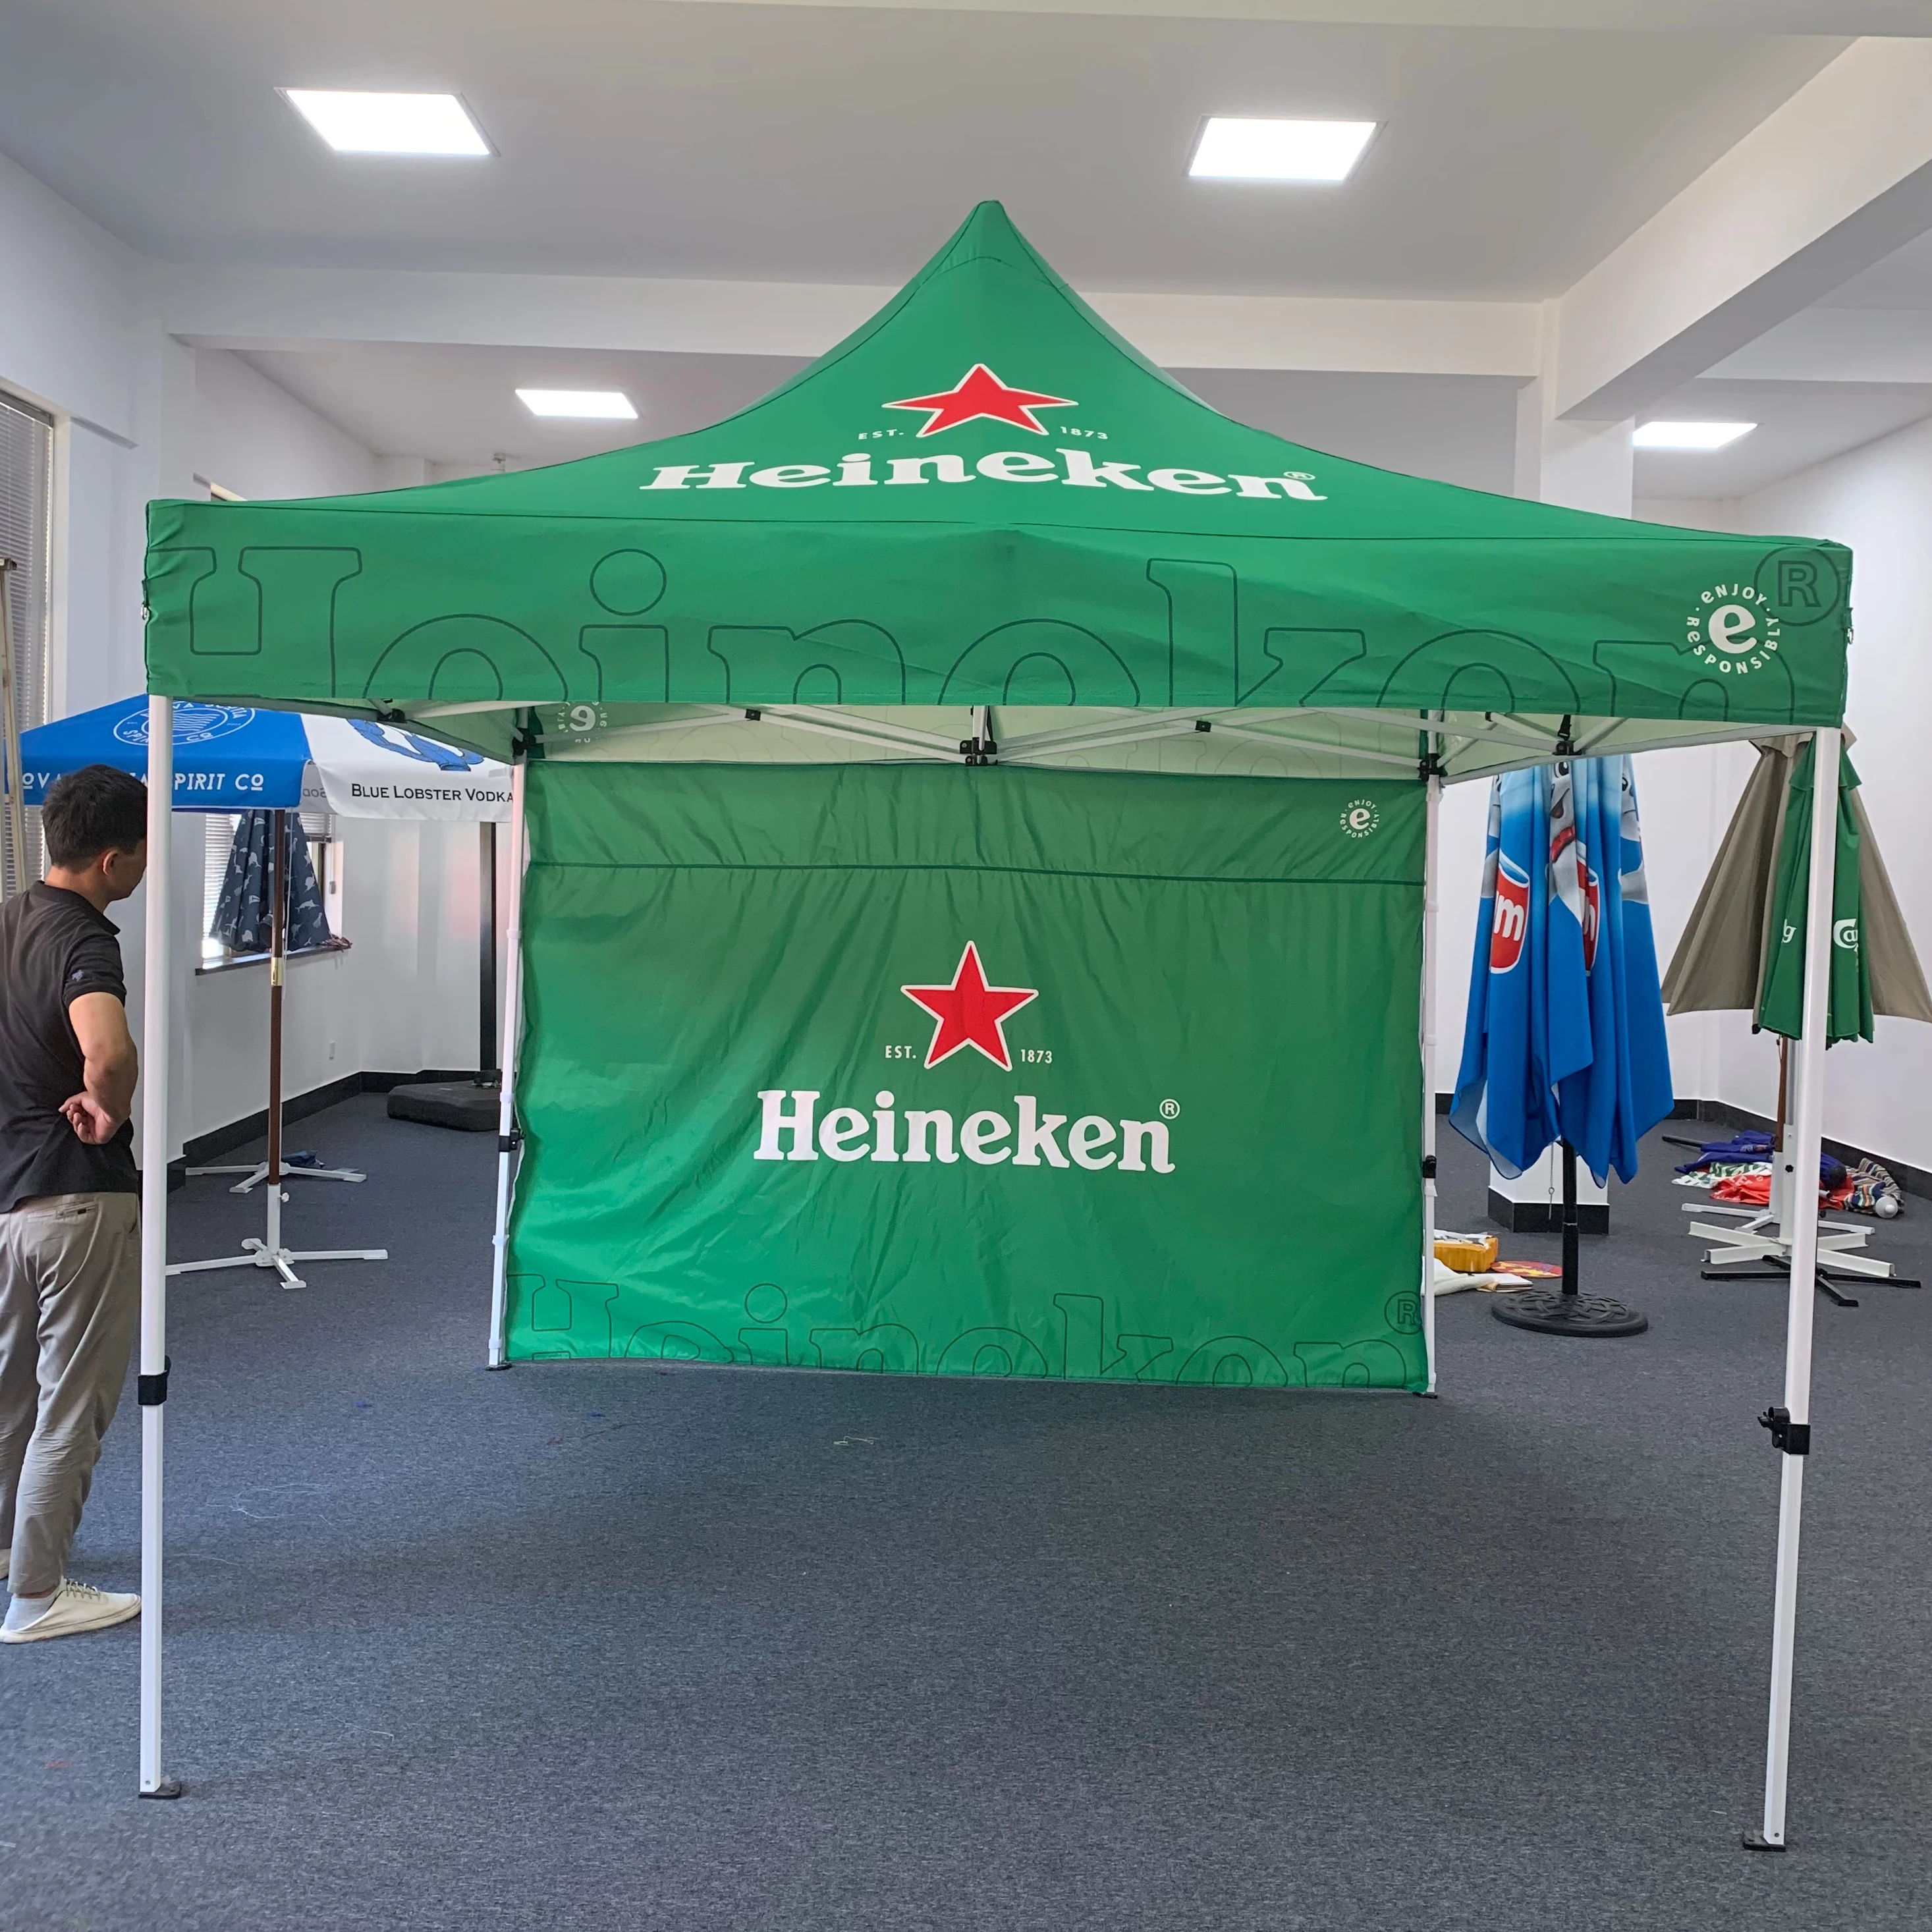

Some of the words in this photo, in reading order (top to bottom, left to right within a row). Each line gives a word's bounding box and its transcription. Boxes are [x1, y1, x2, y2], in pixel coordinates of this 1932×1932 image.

[858, 429, 904, 441] EST.
[1060, 426, 1108, 440] 1873
[172, 773, 225, 790] PIRIT
[351, 783, 390, 798] BLUE
[393, 785, 461, 800] LOBSTER
[885, 1045, 916, 1059] EST.
[1020, 1049, 1053, 1064] 1873
